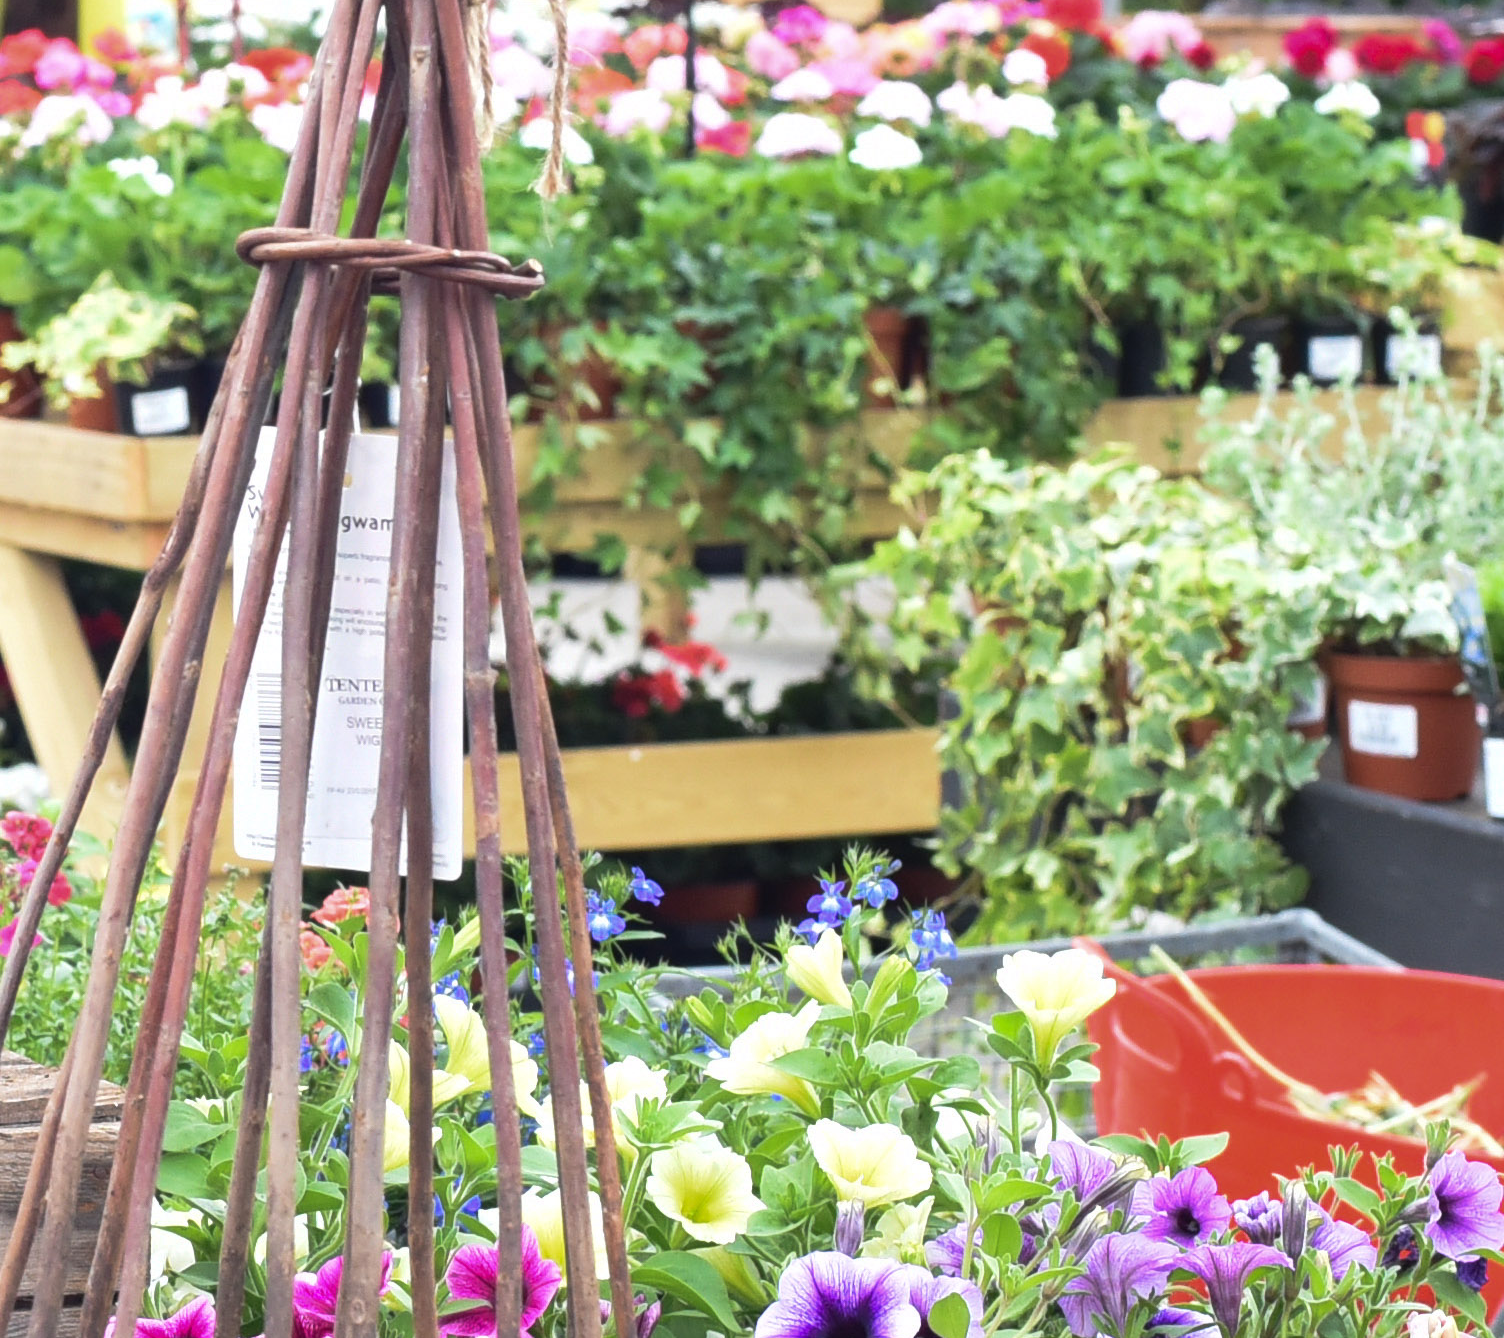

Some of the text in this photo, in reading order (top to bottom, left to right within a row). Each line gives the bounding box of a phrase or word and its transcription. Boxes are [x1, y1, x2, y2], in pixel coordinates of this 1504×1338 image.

[341, 515, 393, 533] gwam
[326, 677, 384, 693] TENTE
[338, 695, 377, 706] GARDEN
